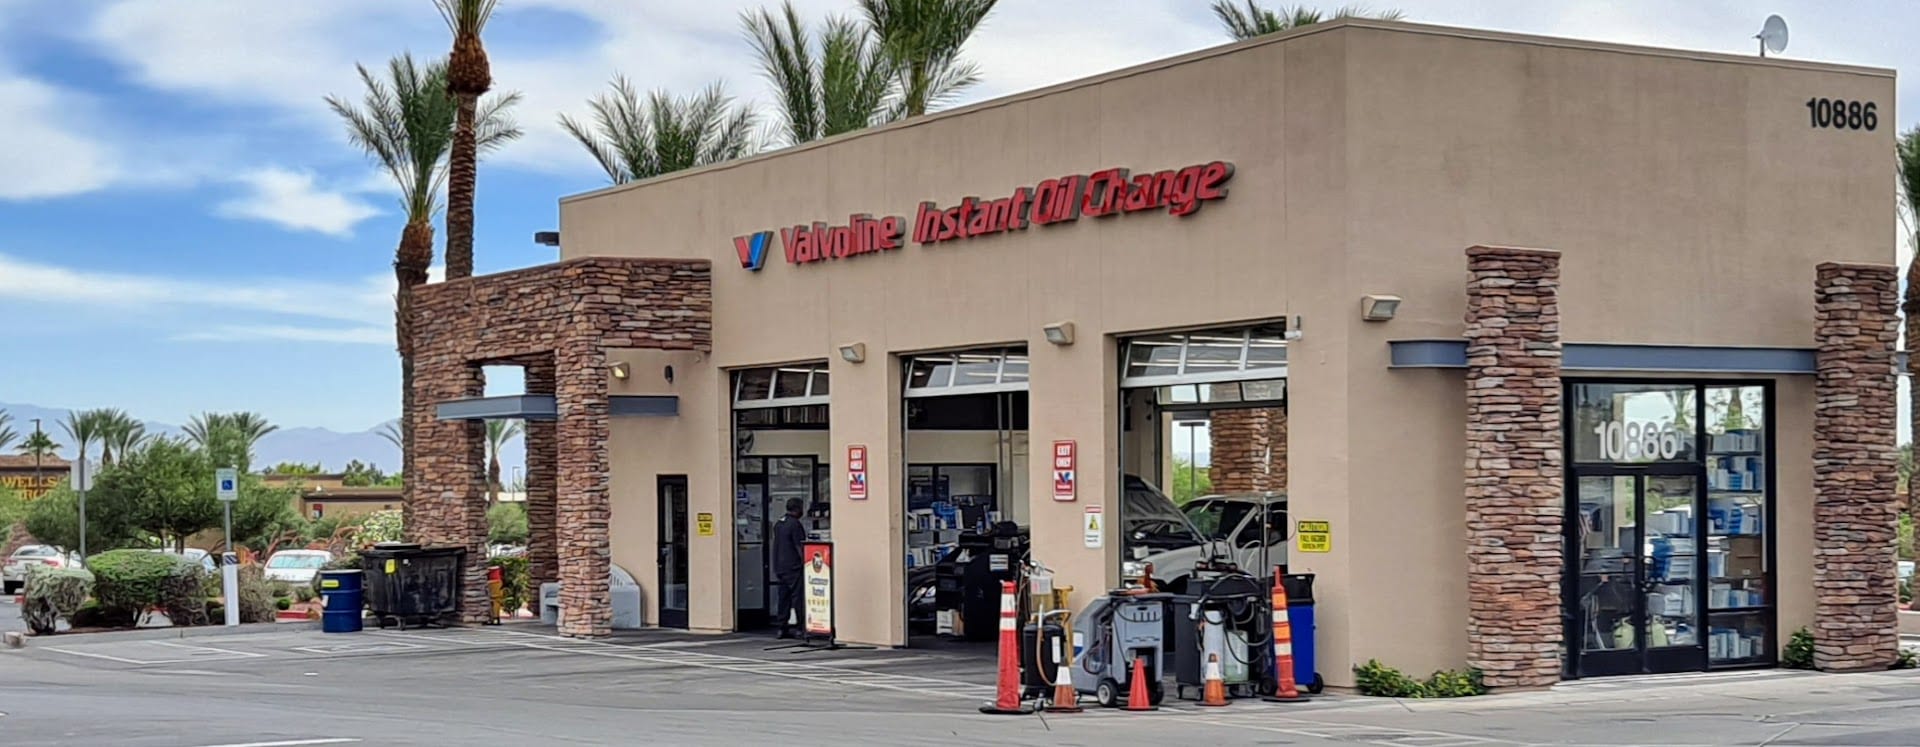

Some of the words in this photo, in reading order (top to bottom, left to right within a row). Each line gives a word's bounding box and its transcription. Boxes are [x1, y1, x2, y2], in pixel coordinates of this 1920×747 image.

[1805, 97, 1878, 131] 10886
[780, 213, 906, 264] Valvoline
[912, 187, 1033, 244] Instant
[1030, 175, 1087, 226] Oil
[1081, 161, 1235, 217] Change
[1594, 421, 1678, 460] 10886
[2, 475, 58, 488] WELLS
